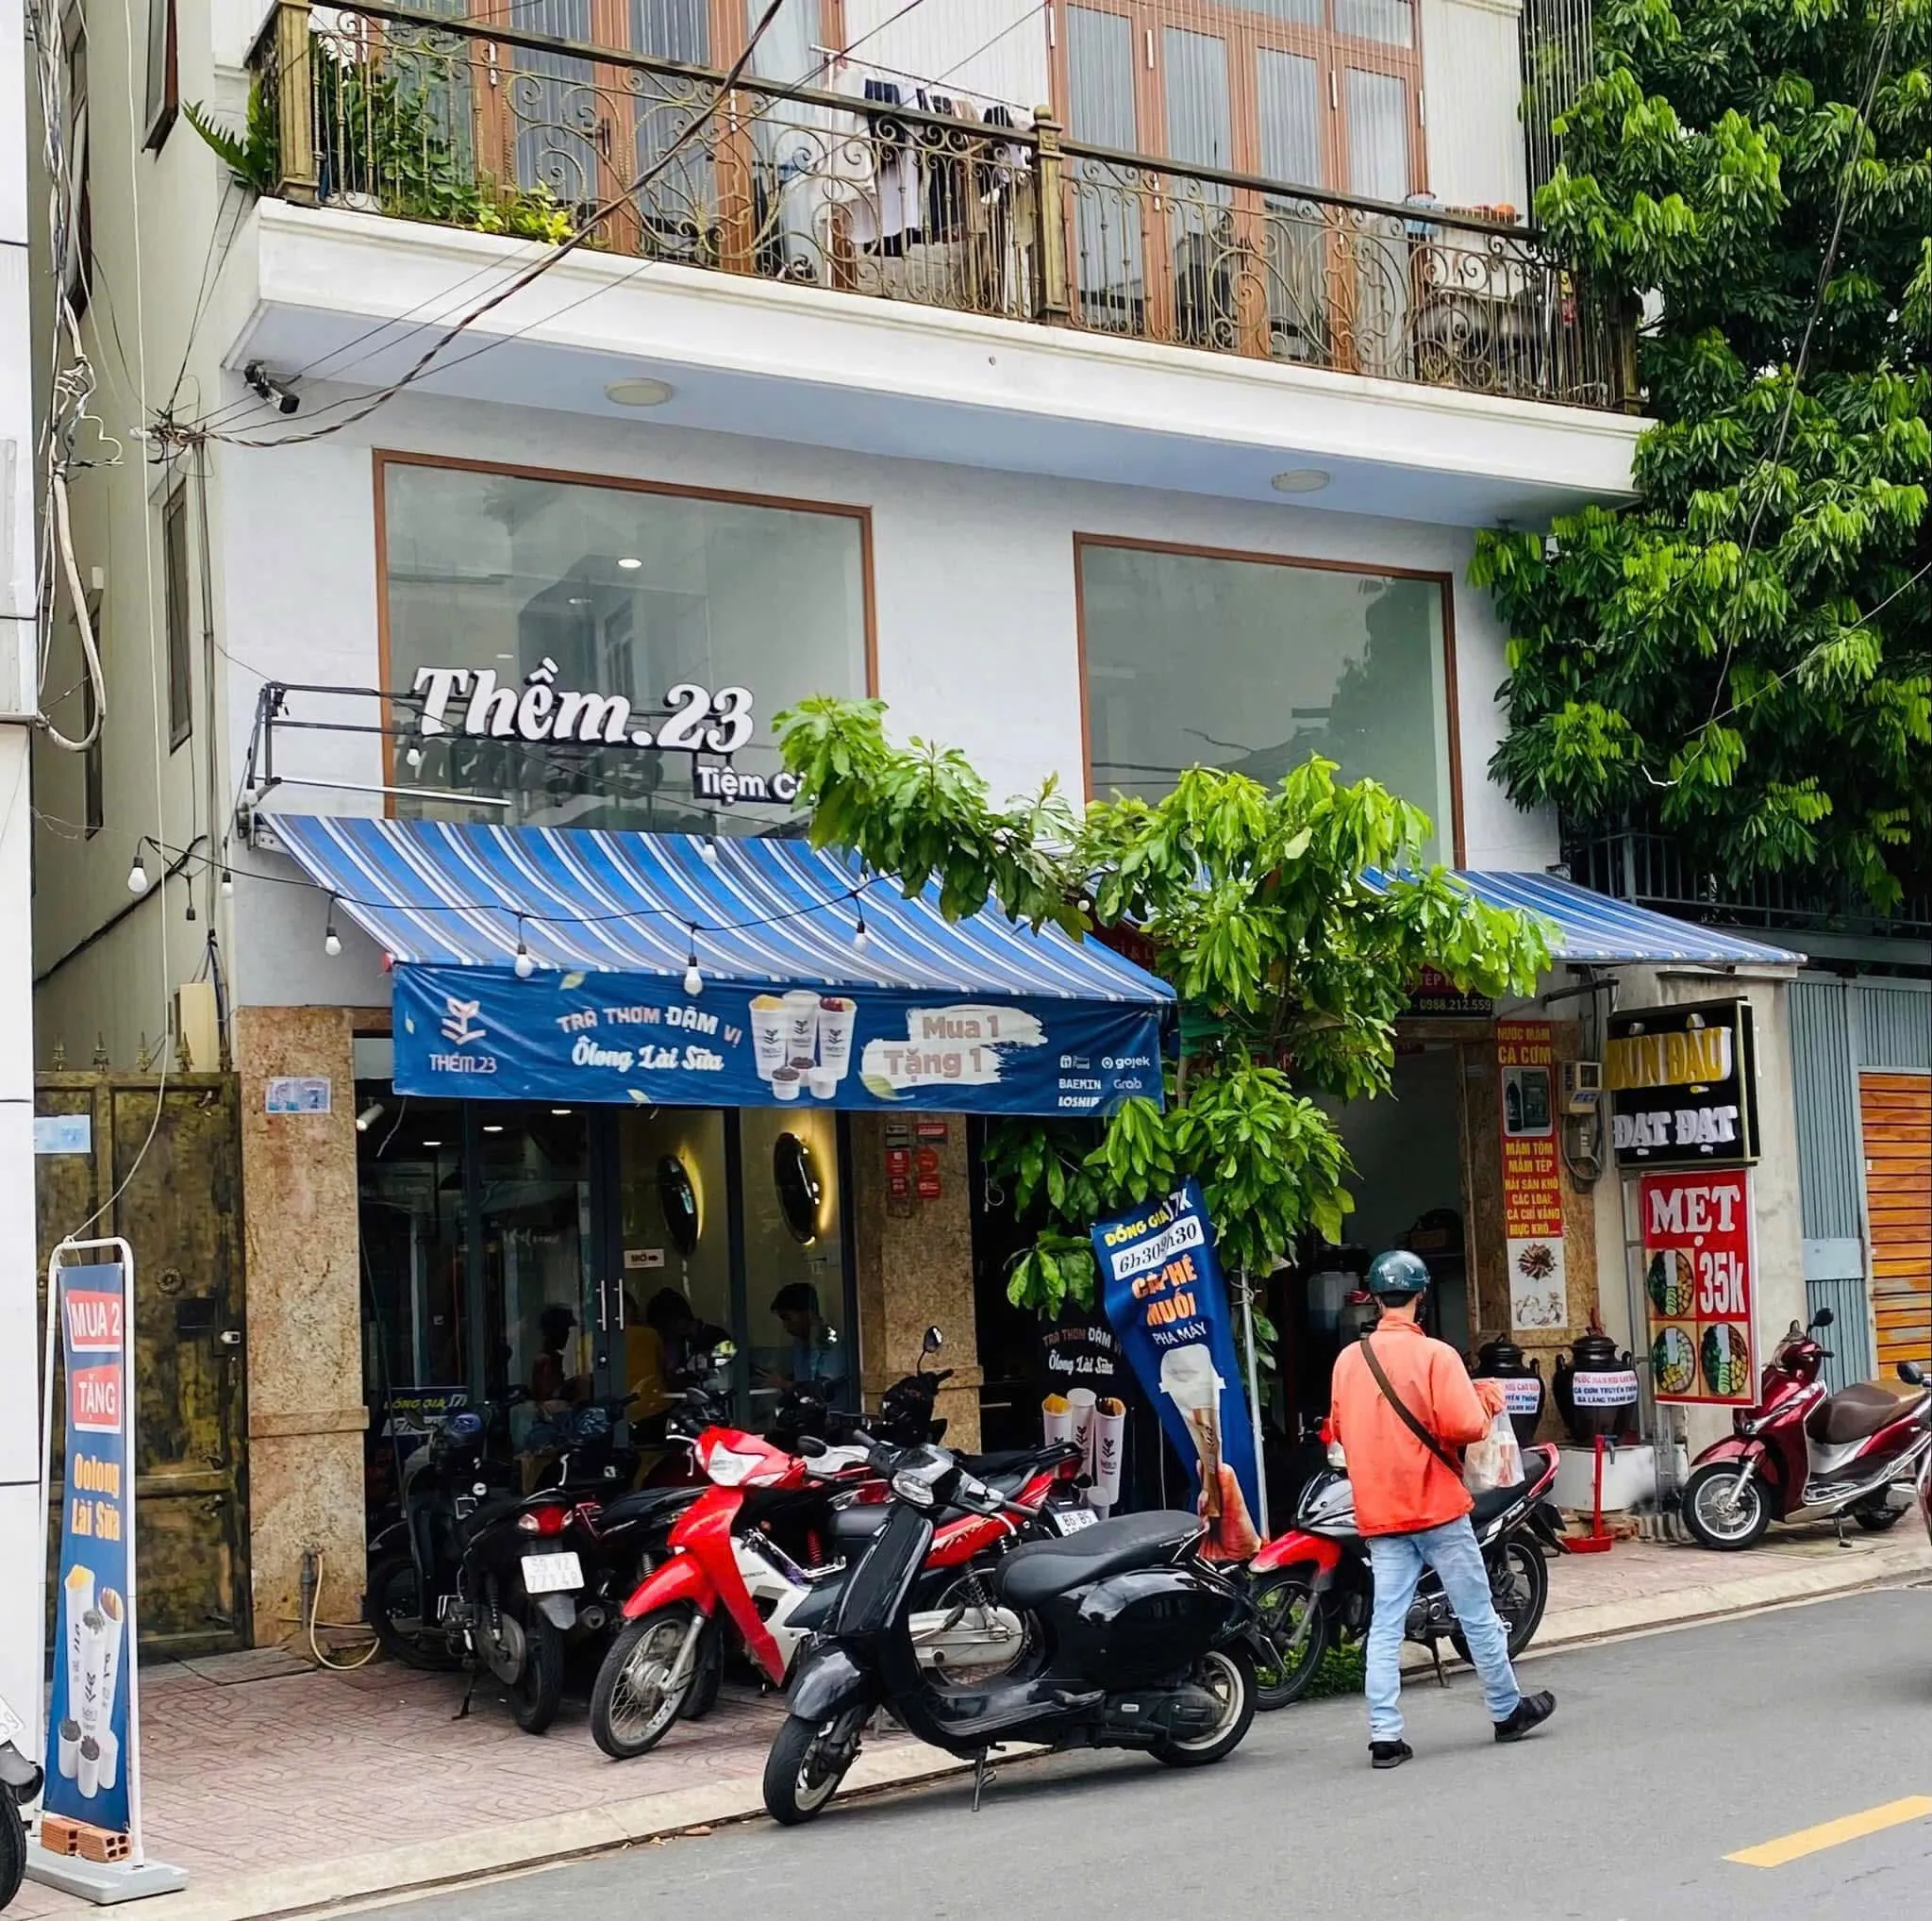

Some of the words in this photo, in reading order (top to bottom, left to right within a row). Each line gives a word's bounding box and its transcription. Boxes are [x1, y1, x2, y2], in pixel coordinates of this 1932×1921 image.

[411, 656, 756, 754] Thềm.23
[697, 765, 767, 804] Tiệm
[556, 1005, 599, 1033] TRÀ
[603, 1005, 660, 1026] THƠM
[664, 1005, 719, 1036] ĐẬM
[724, 1024, 742, 1048] VỊ
[923, 1015, 981, 1039] Mua
[987, 1014, 999, 1037] 1
[572, 1034, 635, 1073] Ôlong
[638, 1044, 680, 1070] Lài
[682, 1044, 725, 1071] Sữa
[883, 1047, 962, 1083] Tặng
[969, 1047, 982, 1073] 1
[1115, 1056, 1151, 1070] gojek
[1667, 1013, 1732, 1094] ĐẬU
[1058, 1077, 1102, 1090] BAEMIN
[1058, 1095, 1105, 1108] LOSHIP
[1114, 1077, 1143, 1090] Grab
[1614, 1111, 1673, 1156] ĐẠT
[1675, 1105, 1739, 1156] ĐẠT
[1650, 1185, 1741, 1246] MẸT
[1104, 1223, 1148, 1247] ĐỒNG
[71, 1301, 108, 1337] MUA
[111, 1301, 121, 1337] 2
[1152, 1328, 1179, 1345] PHA
[1176, 1320, 1208, 1341] MÁY
[1049, 1349, 1074, 1376] Ôlong
[78, 1373, 115, 1419] TẶNG
[74, 1453, 120, 1499] Oolong
[72, 1498, 92, 1536] Lài
[96, 1501, 121, 1542] Sữa
